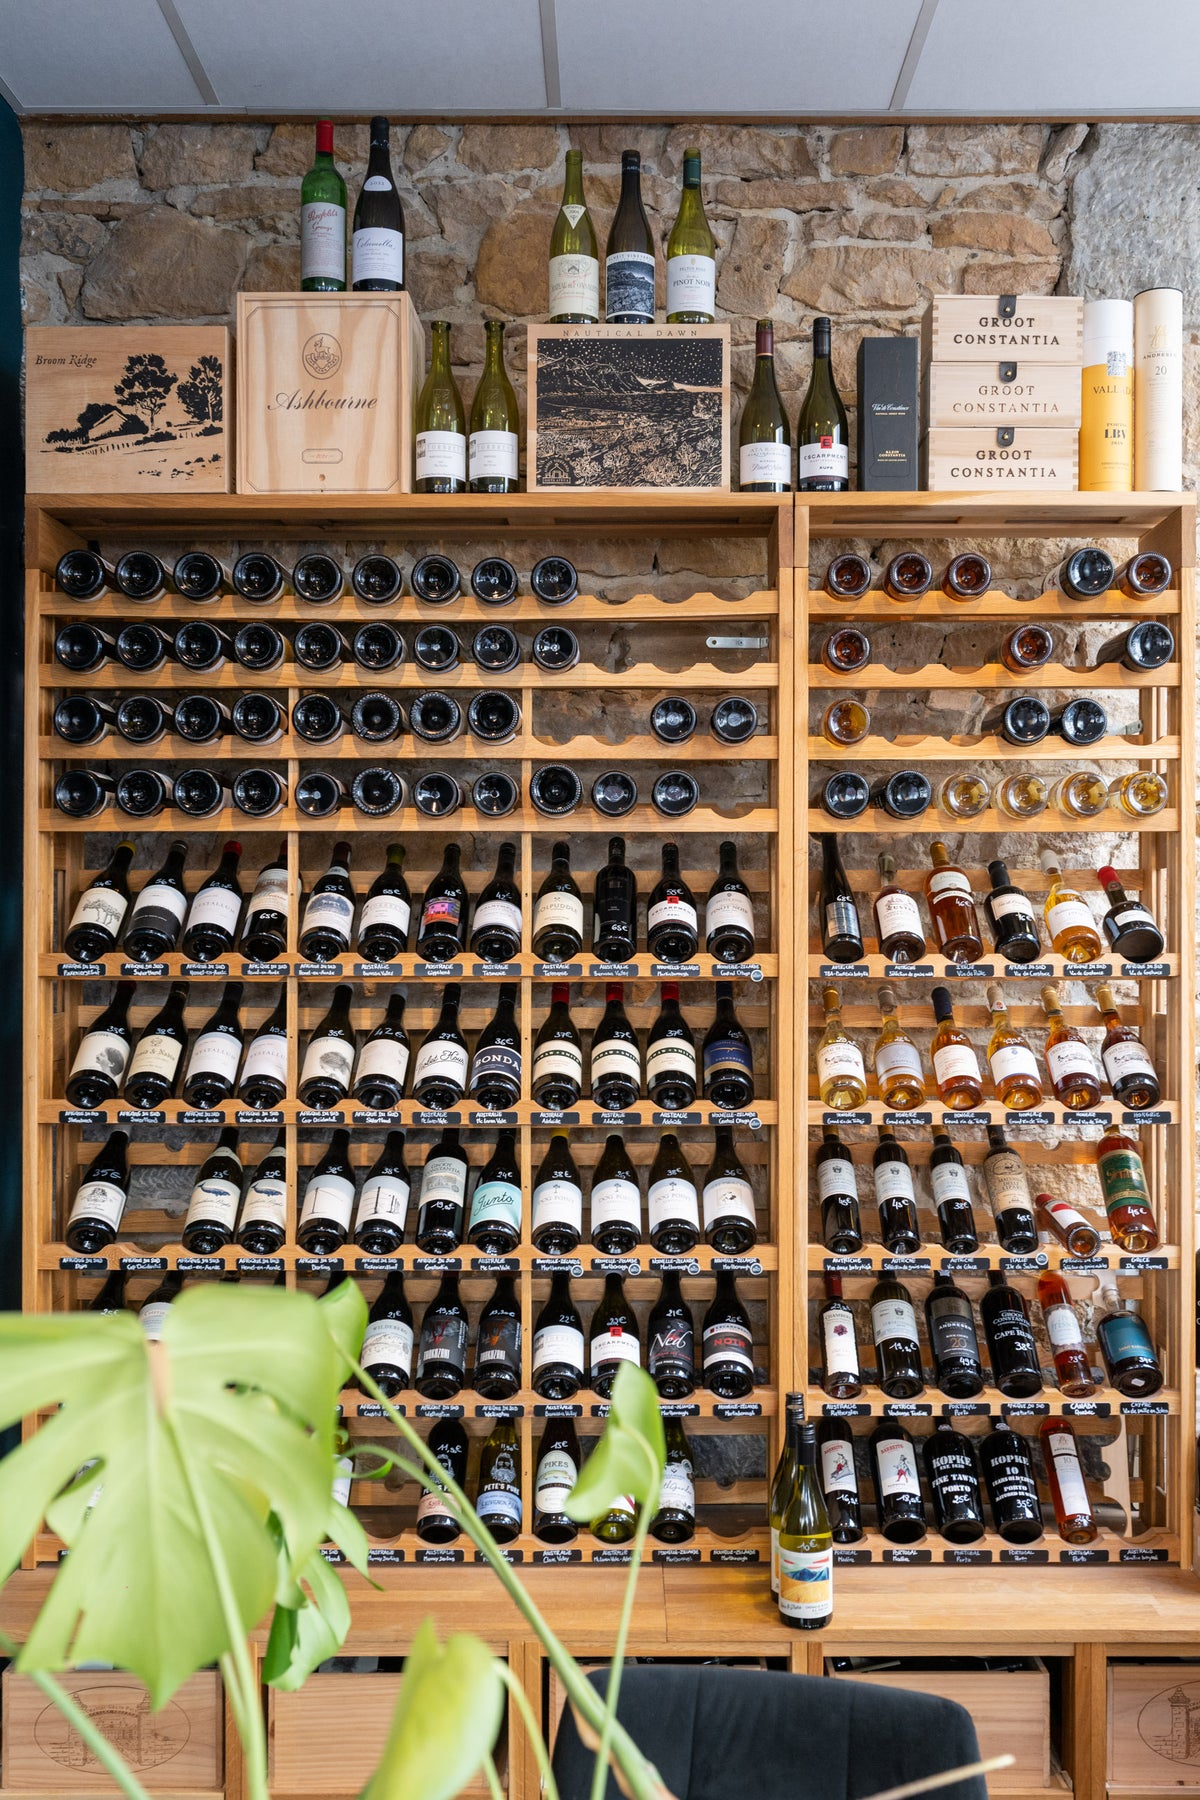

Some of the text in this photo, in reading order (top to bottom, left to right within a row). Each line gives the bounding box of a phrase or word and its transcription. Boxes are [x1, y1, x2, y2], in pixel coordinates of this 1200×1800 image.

[673, 278, 711, 288] PINOT NOIR
[979, 317, 1035, 328] GROOT
[954, 334, 1060, 346] CONSTANTIA
[35, 355, 98, 369] Broom Ridge
[1156, 366, 1167, 376] 20
[979, 385, 1035, 396] GROOT
[267, 389, 379, 413] Ashbourne
[953, 402, 1059, 414] CONSTANTIA
[804, 453, 847, 461] ESCARPMENT
[976, 450, 1032, 461] GROOT
[951, 467, 1056, 478] CONSTANTIA
[554, 1031, 573, 1039] 37€
[613, 1031, 632, 1039] 37€
[666, 1029, 684, 1037] 37€
[495, 1037, 514, 1045] 36€
[474, 1054, 521, 1074] BONDA
[1127, 1206, 1148, 1217] 45€
[666, 1308, 683, 1317] 21€
[559, 1314, 576, 1322] 22€
[607, 1316, 628, 1326] 22€
[994, 1330, 1015, 1340] CAPE
[649, 1329, 693, 1357] Ned
[714, 1337, 746, 1347] NOIR
[950, 1337, 967, 1348] 20
[959, 1357, 977, 1366] 49€
[550, 1440, 568, 1449] 15€
[544, 1461, 568, 1469] PIKES
[932, 1455, 972, 1469] KOPKE
[990, 1454, 1029, 1467] KOPKE
[1006, 1466, 1019, 1475] 10
[932, 1473, 978, 1488] FINE TAWNY
[483, 1483, 505, 1492] PETE'S
[942, 1485, 971, 1494] PORTO
[1016, 1498, 1033, 1508] 35€
[797, 1538, 817, 1551] 10€
